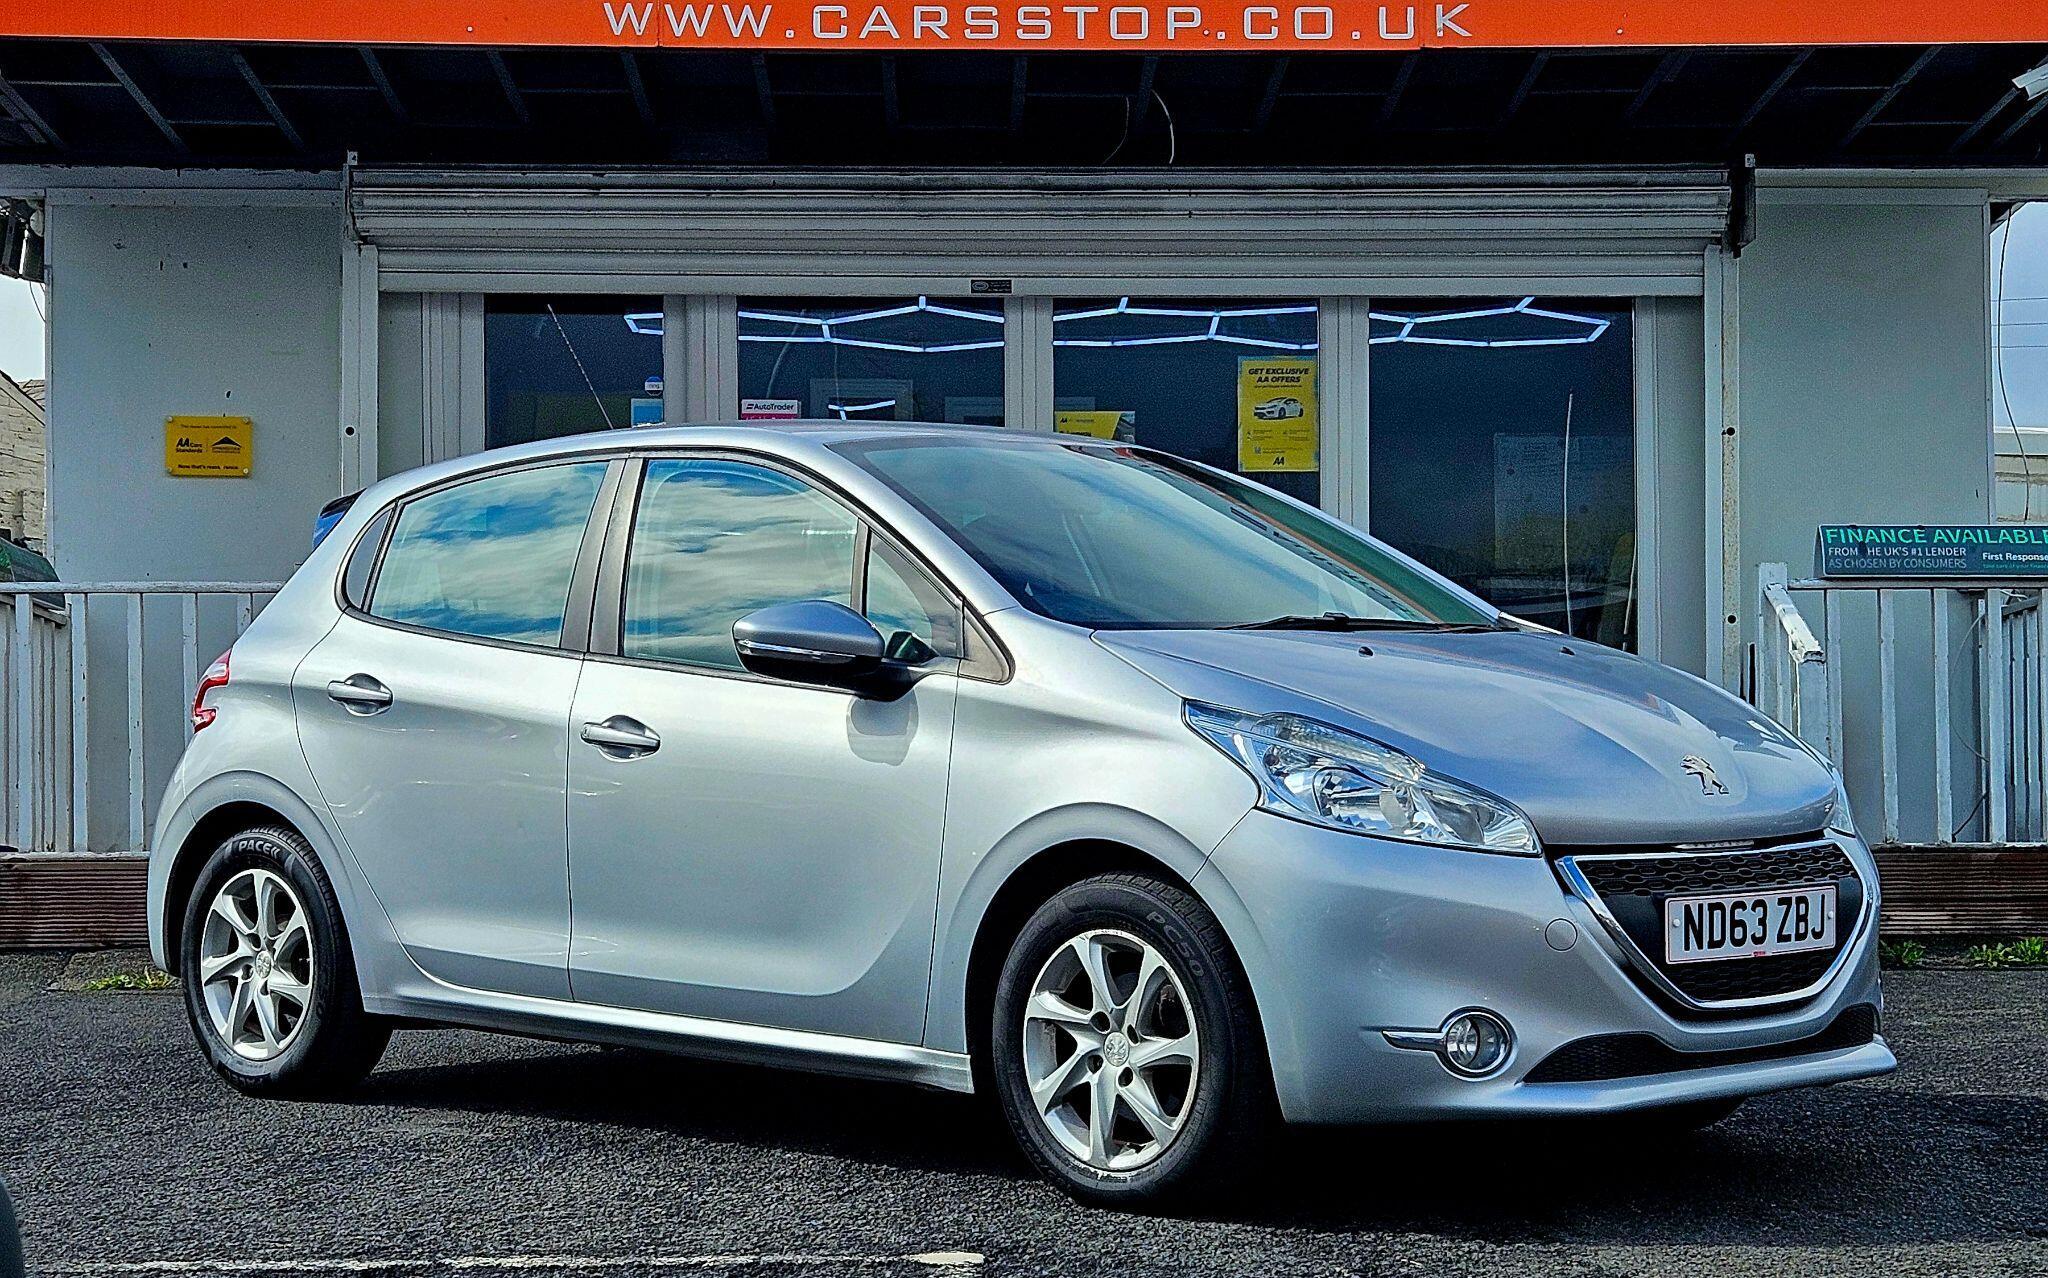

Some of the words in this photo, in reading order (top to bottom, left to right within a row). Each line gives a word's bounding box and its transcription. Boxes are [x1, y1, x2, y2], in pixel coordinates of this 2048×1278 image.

[603, 2, 1472, 40] WWW.CARSSTOP.CO.UK
[1266, 367, 1310, 375] EXCLUSIVE
[176, 437, 190, 448] AA
[1273, 456, 1285, 466] AA
[1825, 528, 1927, 543] FINANCE
[1828, 546, 1858, 556] FROM
[1864, 546, 1881, 556] HE
[1883, 546, 1909, 556] UK'S
[1911, 547, 1923, 556] #1
[1925, 546, 1967, 556] LENDER
[1982, 552, 2004, 560] First
[1828, 558, 1842, 569] AS
[1844, 558, 1887, 569] CHOSEN
[1889, 558, 1902, 569] BY
[1903, 558, 1967, 569] CONSUMERS
[1683, 898, 1768, 952] ND63
[1776, 893, 1826, 944] ZBJ
